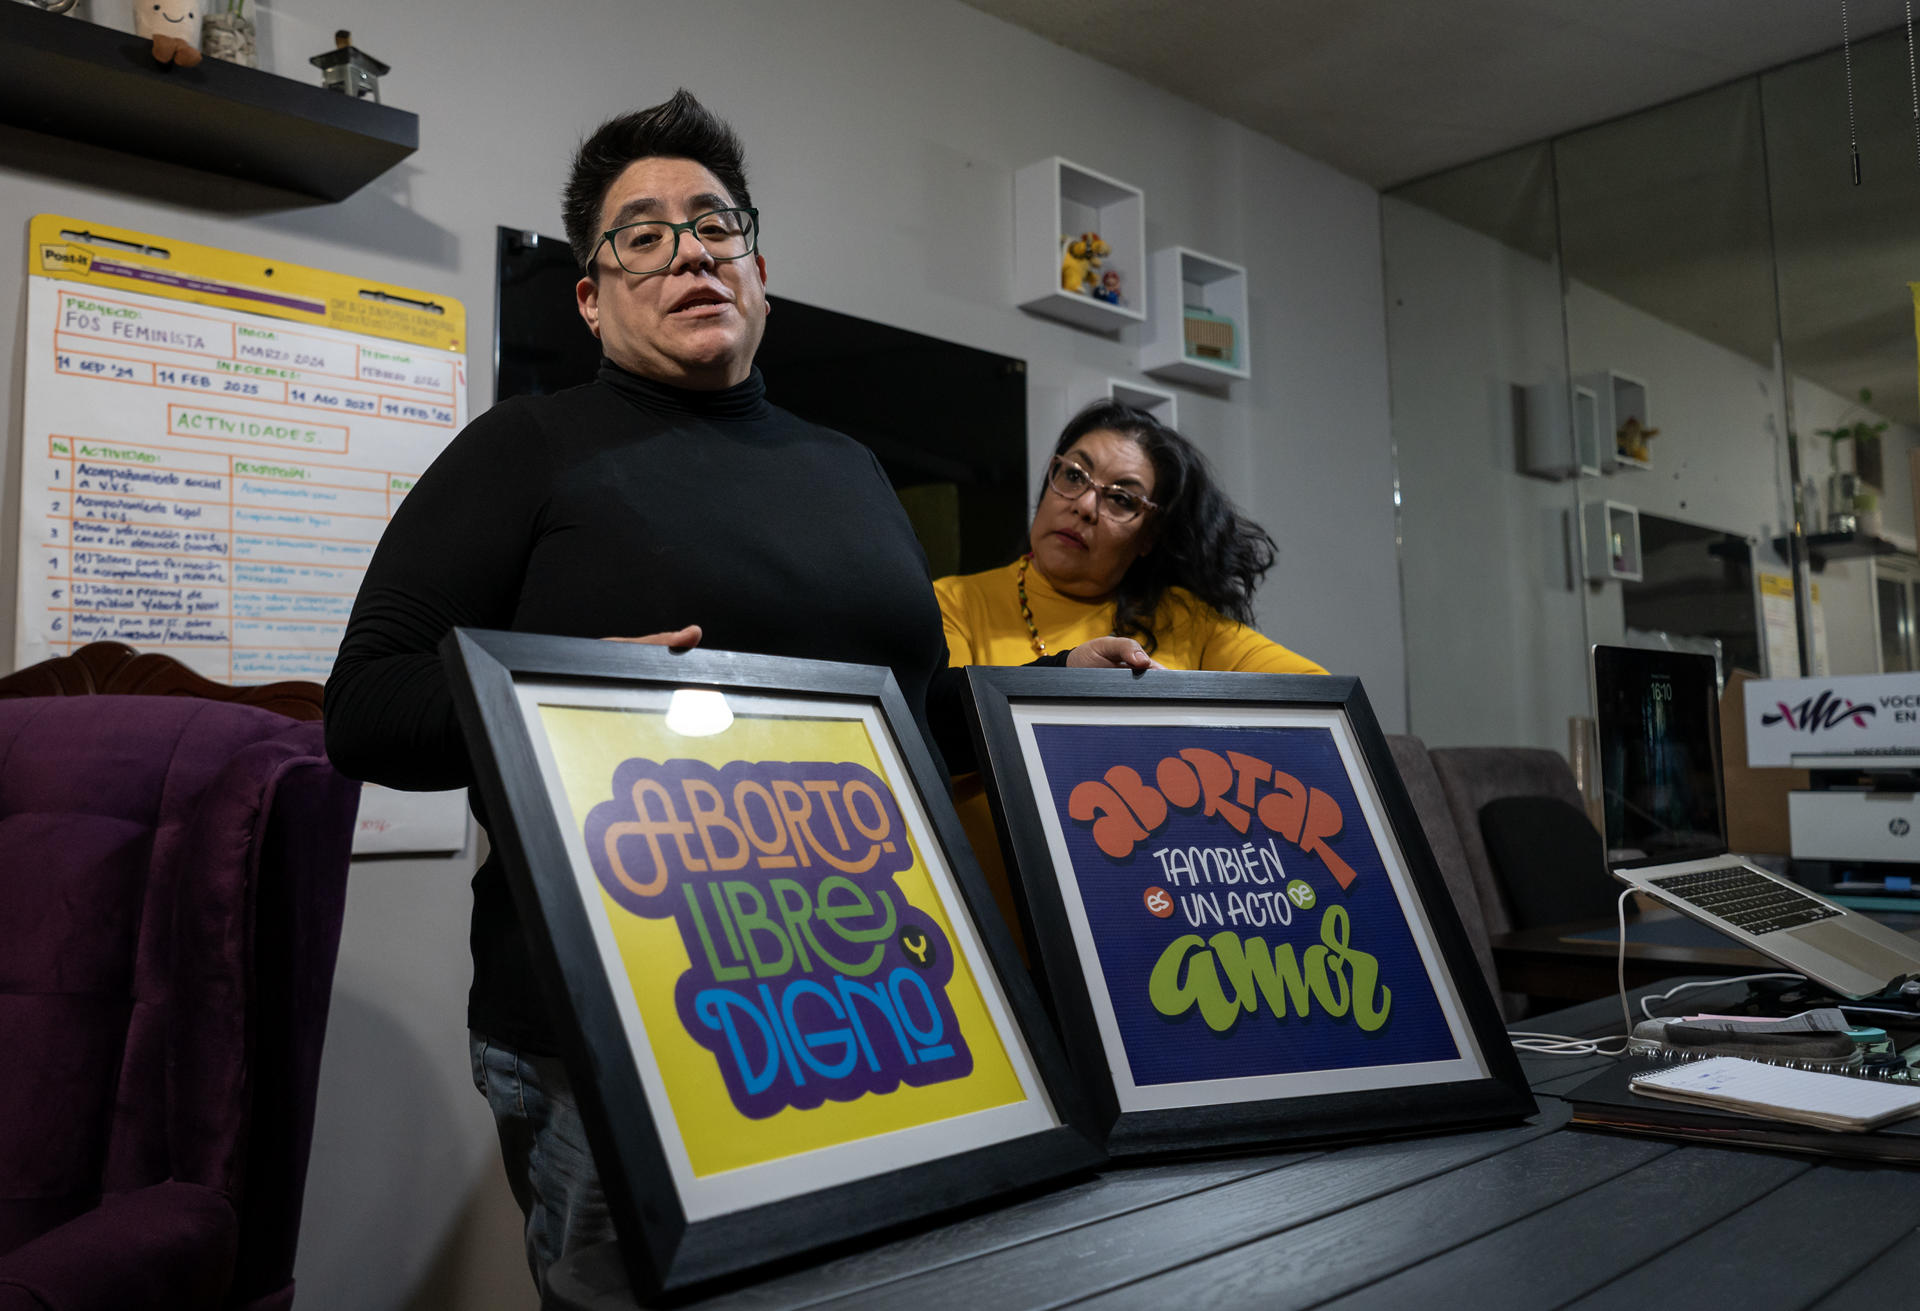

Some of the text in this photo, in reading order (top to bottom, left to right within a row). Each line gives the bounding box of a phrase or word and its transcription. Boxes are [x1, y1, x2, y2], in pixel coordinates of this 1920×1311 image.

[45, 248, 89, 267] Post-it
[65, 311, 205, 349] FOS FEMINISTA
[240, 345, 290, 361] MARZO
[79, 361, 106, 374] SEP
[158, 371, 260, 395] 14 FEB 2025
[291, 389, 306, 402] 14
[313, 393, 339, 406] AGO
[54, 469, 60, 481] 1
[184, 478, 222, 491] social
[52, 501, 61, 511] 2
[174, 504, 202, 520] legal
[50, 528, 58, 539] 3
[51, 617, 62, 631] 6
[1651, 682, 1672, 701] 16:10
[1895, 710, 1917, 723] EN
[604, 778, 897, 897] ABORTO
[1153, 838, 1286, 886] TAMBIÉN
[1181, 892, 1225, 927] UN
[1227, 892, 1293, 928] ACTO
[903, 935, 928, 962] Y
[1149, 905, 1392, 1032] amor
[695, 967, 956, 1096] DIGNO
